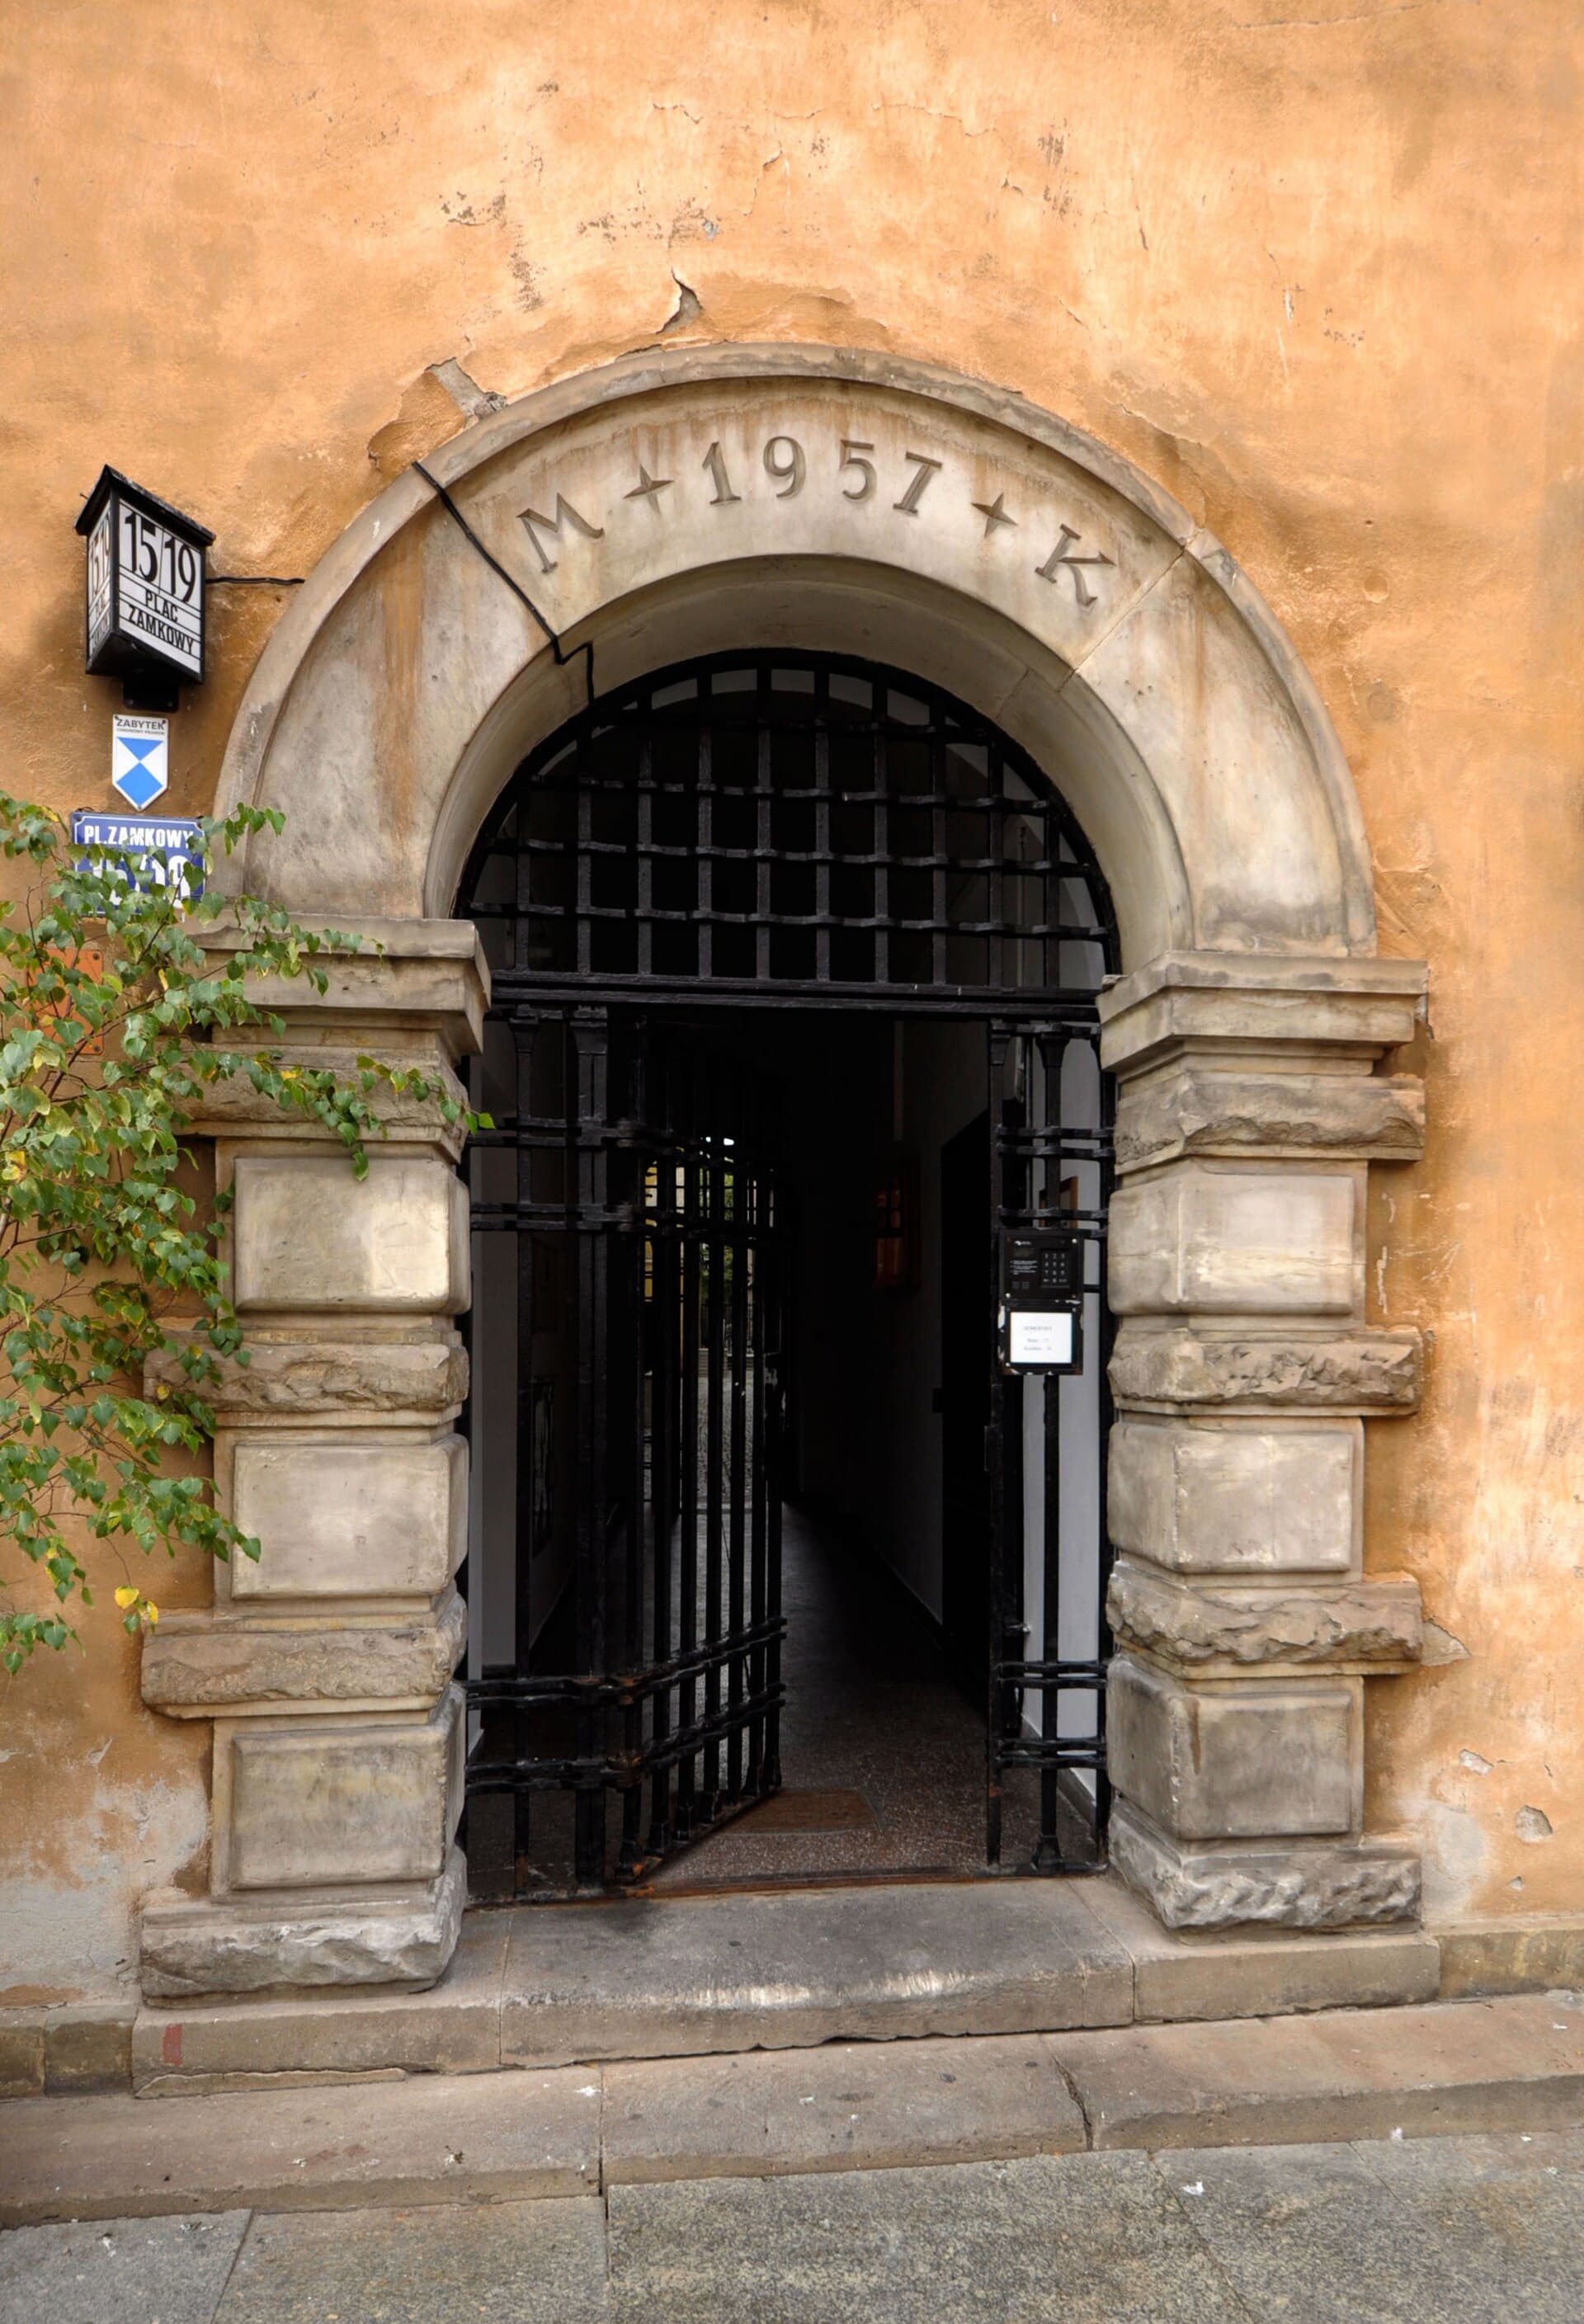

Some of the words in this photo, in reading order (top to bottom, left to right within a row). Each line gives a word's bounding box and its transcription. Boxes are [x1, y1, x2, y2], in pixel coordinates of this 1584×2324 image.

[516, 492, 605, 575] M
[700, 435, 942, 516] 1957
[1034, 523, 1115, 607] K
[125, 511, 196, 603] 15/19
[129, 604, 194, 655] ZAMKOWY
[145, 588, 178, 624] PLAC
[117, 719, 165, 730] ZABYTEK
